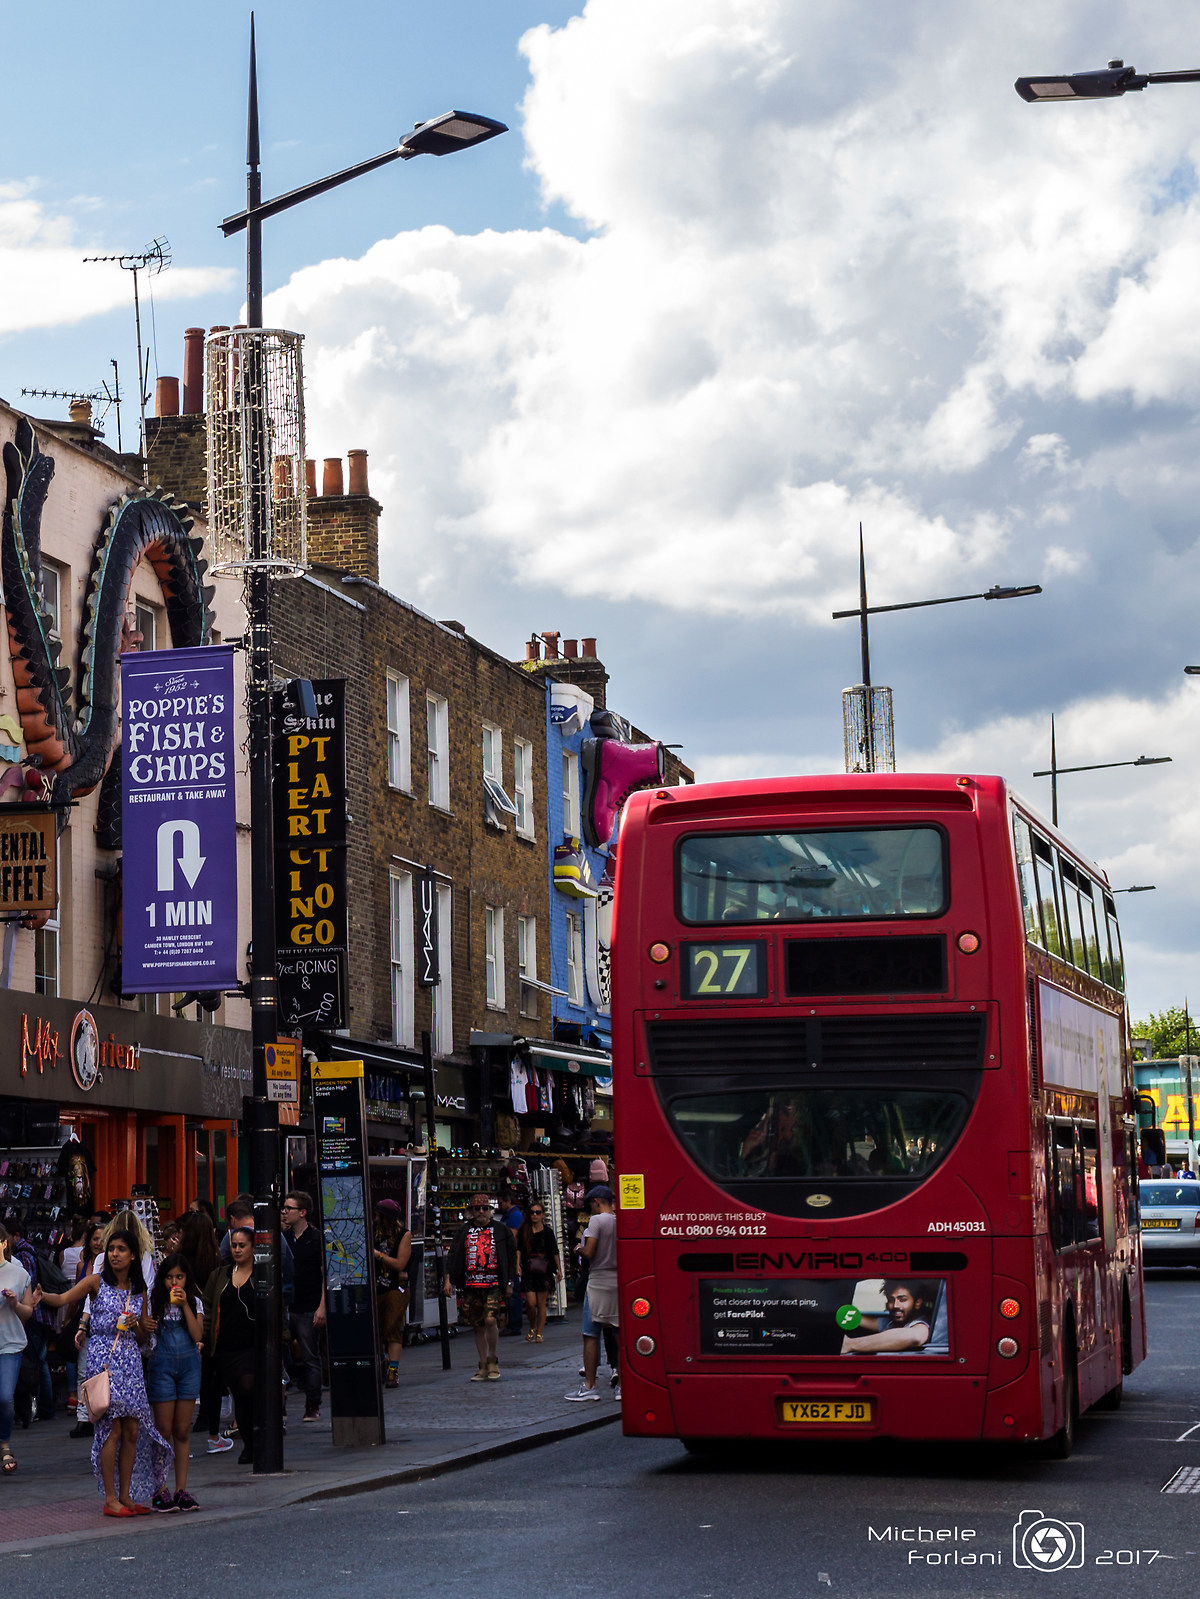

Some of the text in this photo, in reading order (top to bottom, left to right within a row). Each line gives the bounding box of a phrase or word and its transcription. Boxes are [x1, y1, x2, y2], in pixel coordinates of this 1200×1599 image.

[164, 682, 188, 695] 1952
[129, 694, 224, 720] POPPIE'S
[129, 721, 225, 753] FISH &
[129, 752, 226, 783] CHIPS
[129, 789, 226, 803] RESTAURANT & TAKE AWAY
[145, 900, 212, 927] 1 MIN
[694, 949, 752, 993] 27
[301, 976, 311, 990] &
[660, 1213, 684, 1221] WANT
[686, 1213, 697, 1221] TO
[699, 1213, 723, 1221] DRIVE
[660, 1225, 767, 1236] CALL 0800 694 0112
[713, 1311, 726, 1319] get
[790, 1404, 865, 1418] YX62 FJD
